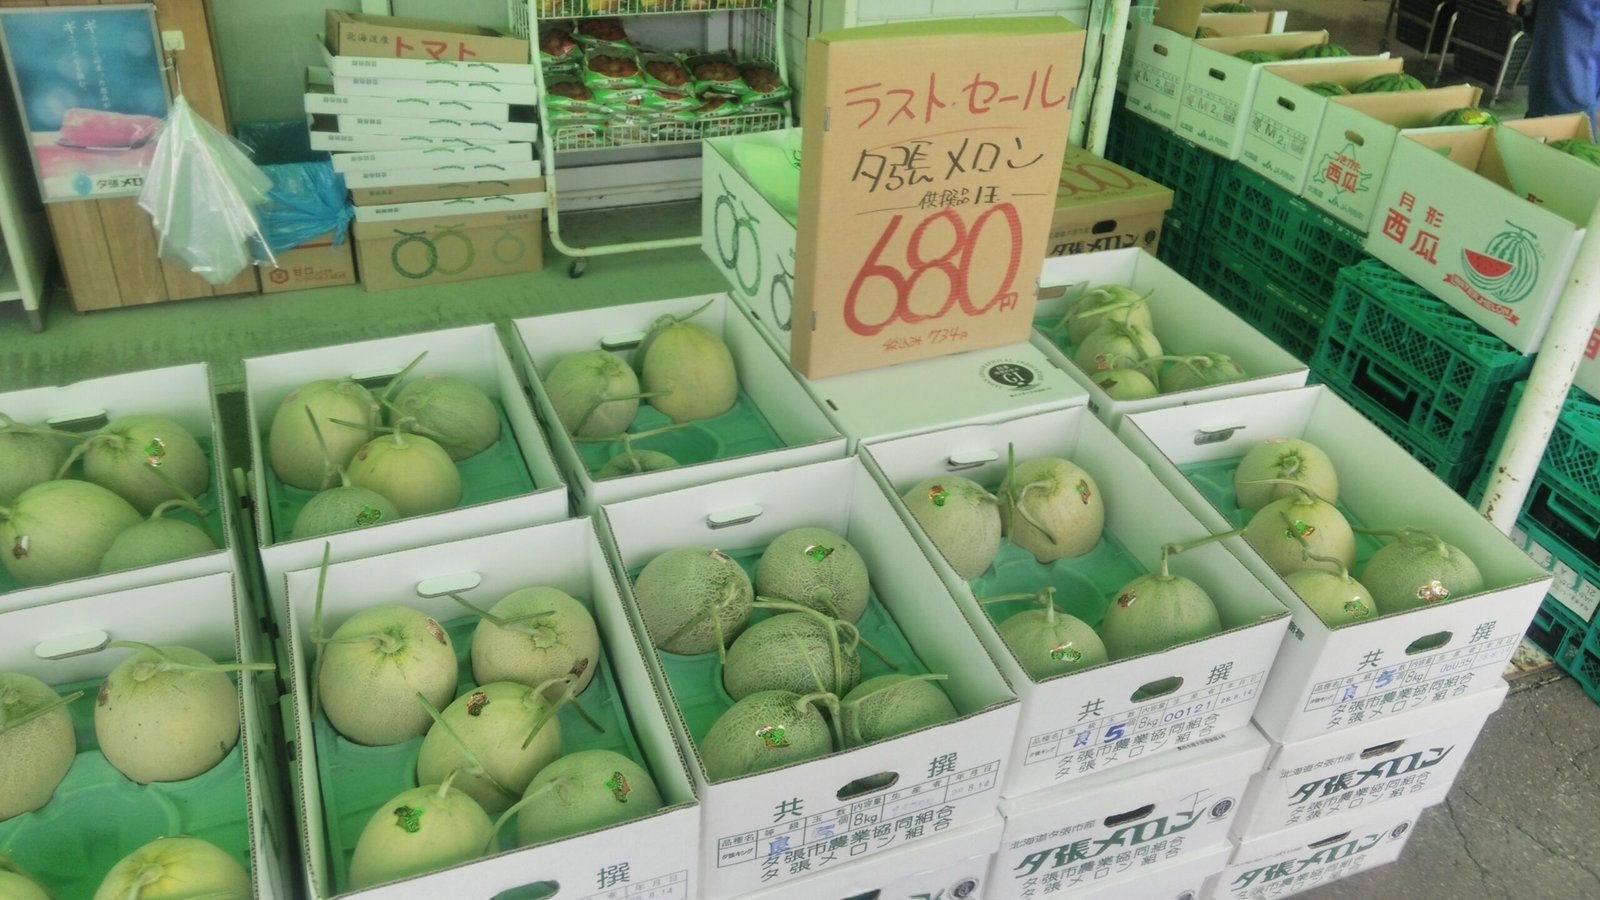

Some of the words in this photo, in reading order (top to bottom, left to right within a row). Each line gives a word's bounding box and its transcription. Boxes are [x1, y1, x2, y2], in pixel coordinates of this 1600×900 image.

[396, 36, 476, 61] トマト
[851, 137, 1044, 193] 夕張メロン
[1326, 161, 1358, 194] 西瓜
[1398, 191, 1445, 229] 月形
[1382, 207, 1441, 266] 西瓜
[1003, 371, 1026, 384] GI
[1357, 649, 1384, 671] 共
[1469, 620, 1497, 644] 撰
[1078, 698, 1105, 721] 共
[1206, 661, 1233, 685] 撰
[1331, 672, 1475, 717] 夕張市農業協同組合
[1405, 670, 1423, 684] 8kg
[1073, 730, 1091, 748] 良
[1104, 723, 1127, 743] 5
[1138, 715, 1159, 729] 8kg
[1164, 701, 1212, 722] 00121
[1326, 685, 1468, 729] 夕張メロン組合
[1055, 725, 1215, 780] 夕張メロン組合
[1059, 713, 1220, 768] 夕張市農業協同組合
[773, 797, 804, 823] 共
[927, 752, 958, 779] 撰
[1288, 744, 1456, 806] 夕張メロン
[761, 805, 956, 870] 夕張市農業協同組合
[853, 812, 878, 827] 8kg
[1009, 819, 1096, 850] 北海道夕張市産
[1013, 807, 1207, 879] 夕張メロン
[597, 861, 630, 890] 撰
[761, 818, 953, 882] 夕張メロン組合
[1023, 836, 1186, 889] 夕張市農業協同組合
[1230, 830, 1388, 892] 夕張メロン
